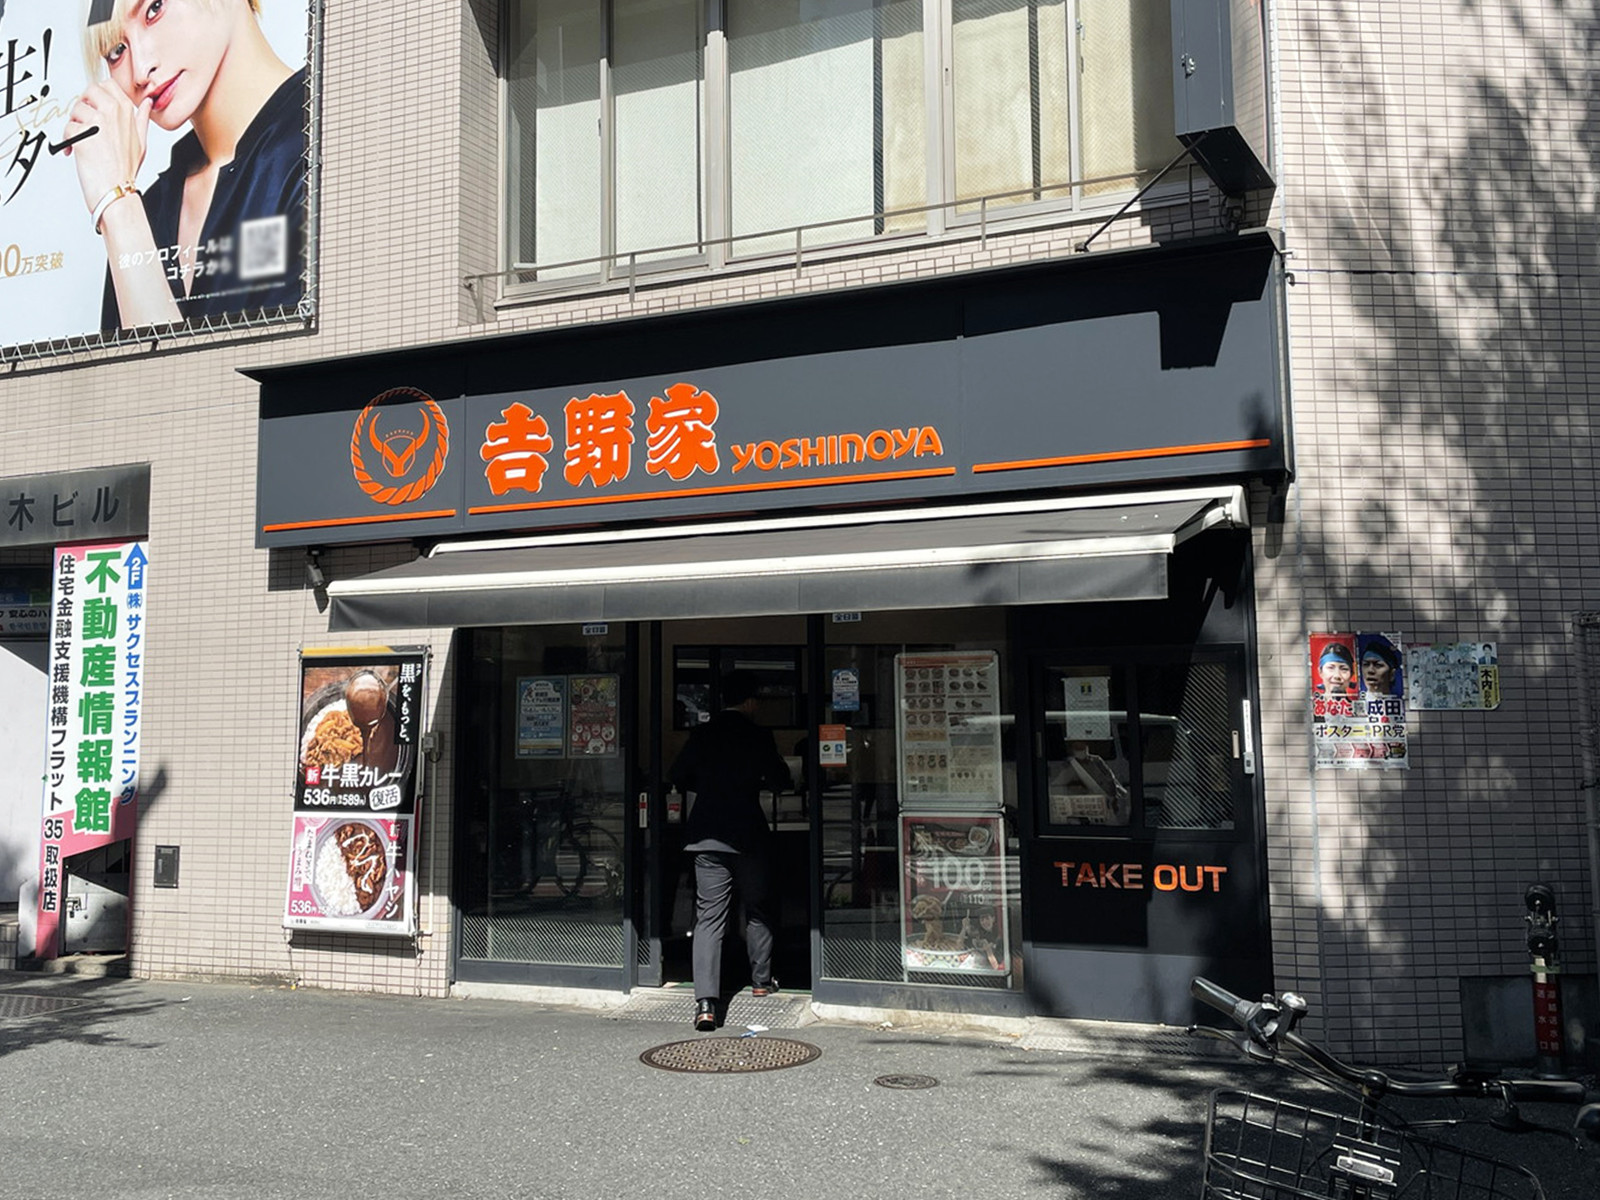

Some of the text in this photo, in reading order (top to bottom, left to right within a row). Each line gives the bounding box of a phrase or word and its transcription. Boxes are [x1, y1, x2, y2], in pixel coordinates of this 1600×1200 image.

[480, 383, 720, 495] 吉野家
[8, 486, 119, 531] 木ビル
[131, 557, 142, 586] 2F
[74, 550, 121, 833] 不動産情報館
[1314, 699, 1402, 717] あなた 成田
[1315, 725, 1364, 738] ポスター
[321, 763, 402, 788] 牛黒カレー
[385, 841, 402, 919] 牛ハヤシ
[1053, 861, 1228, 892] TAKE OUT
